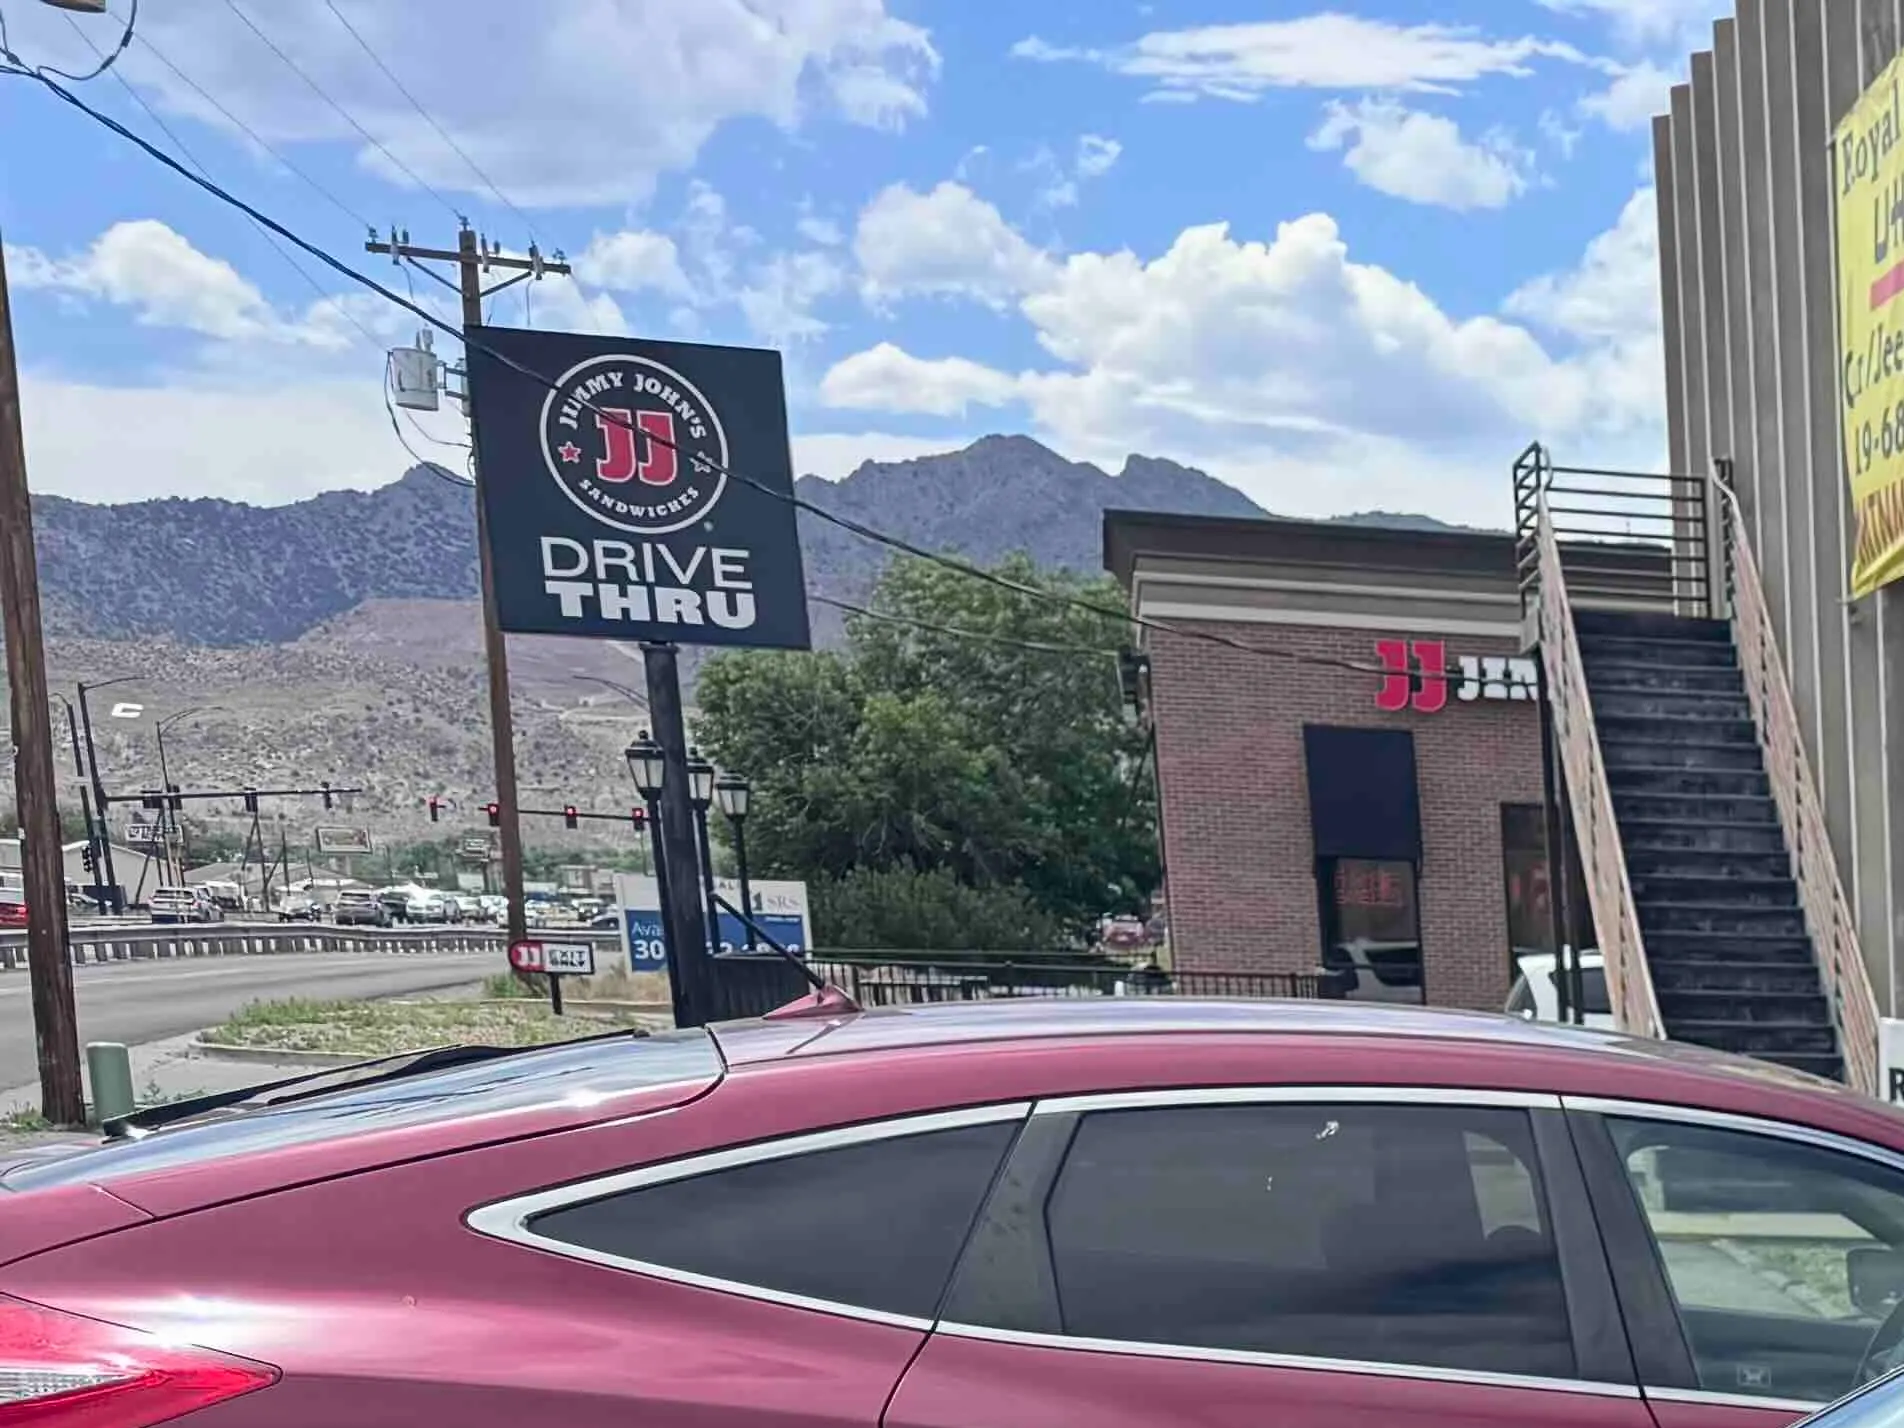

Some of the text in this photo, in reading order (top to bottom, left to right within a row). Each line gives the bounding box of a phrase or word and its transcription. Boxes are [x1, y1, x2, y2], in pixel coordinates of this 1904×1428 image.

[559, 372, 706, 438] JIMMY JOHN'S
[596, 407, 678, 486] JJ
[579, 479, 699, 517] SANDWICHES
[540, 536, 753, 589] DRIVE
[544, 580, 756, 629] THRU
[1375, 640, 1447, 713] JJ
